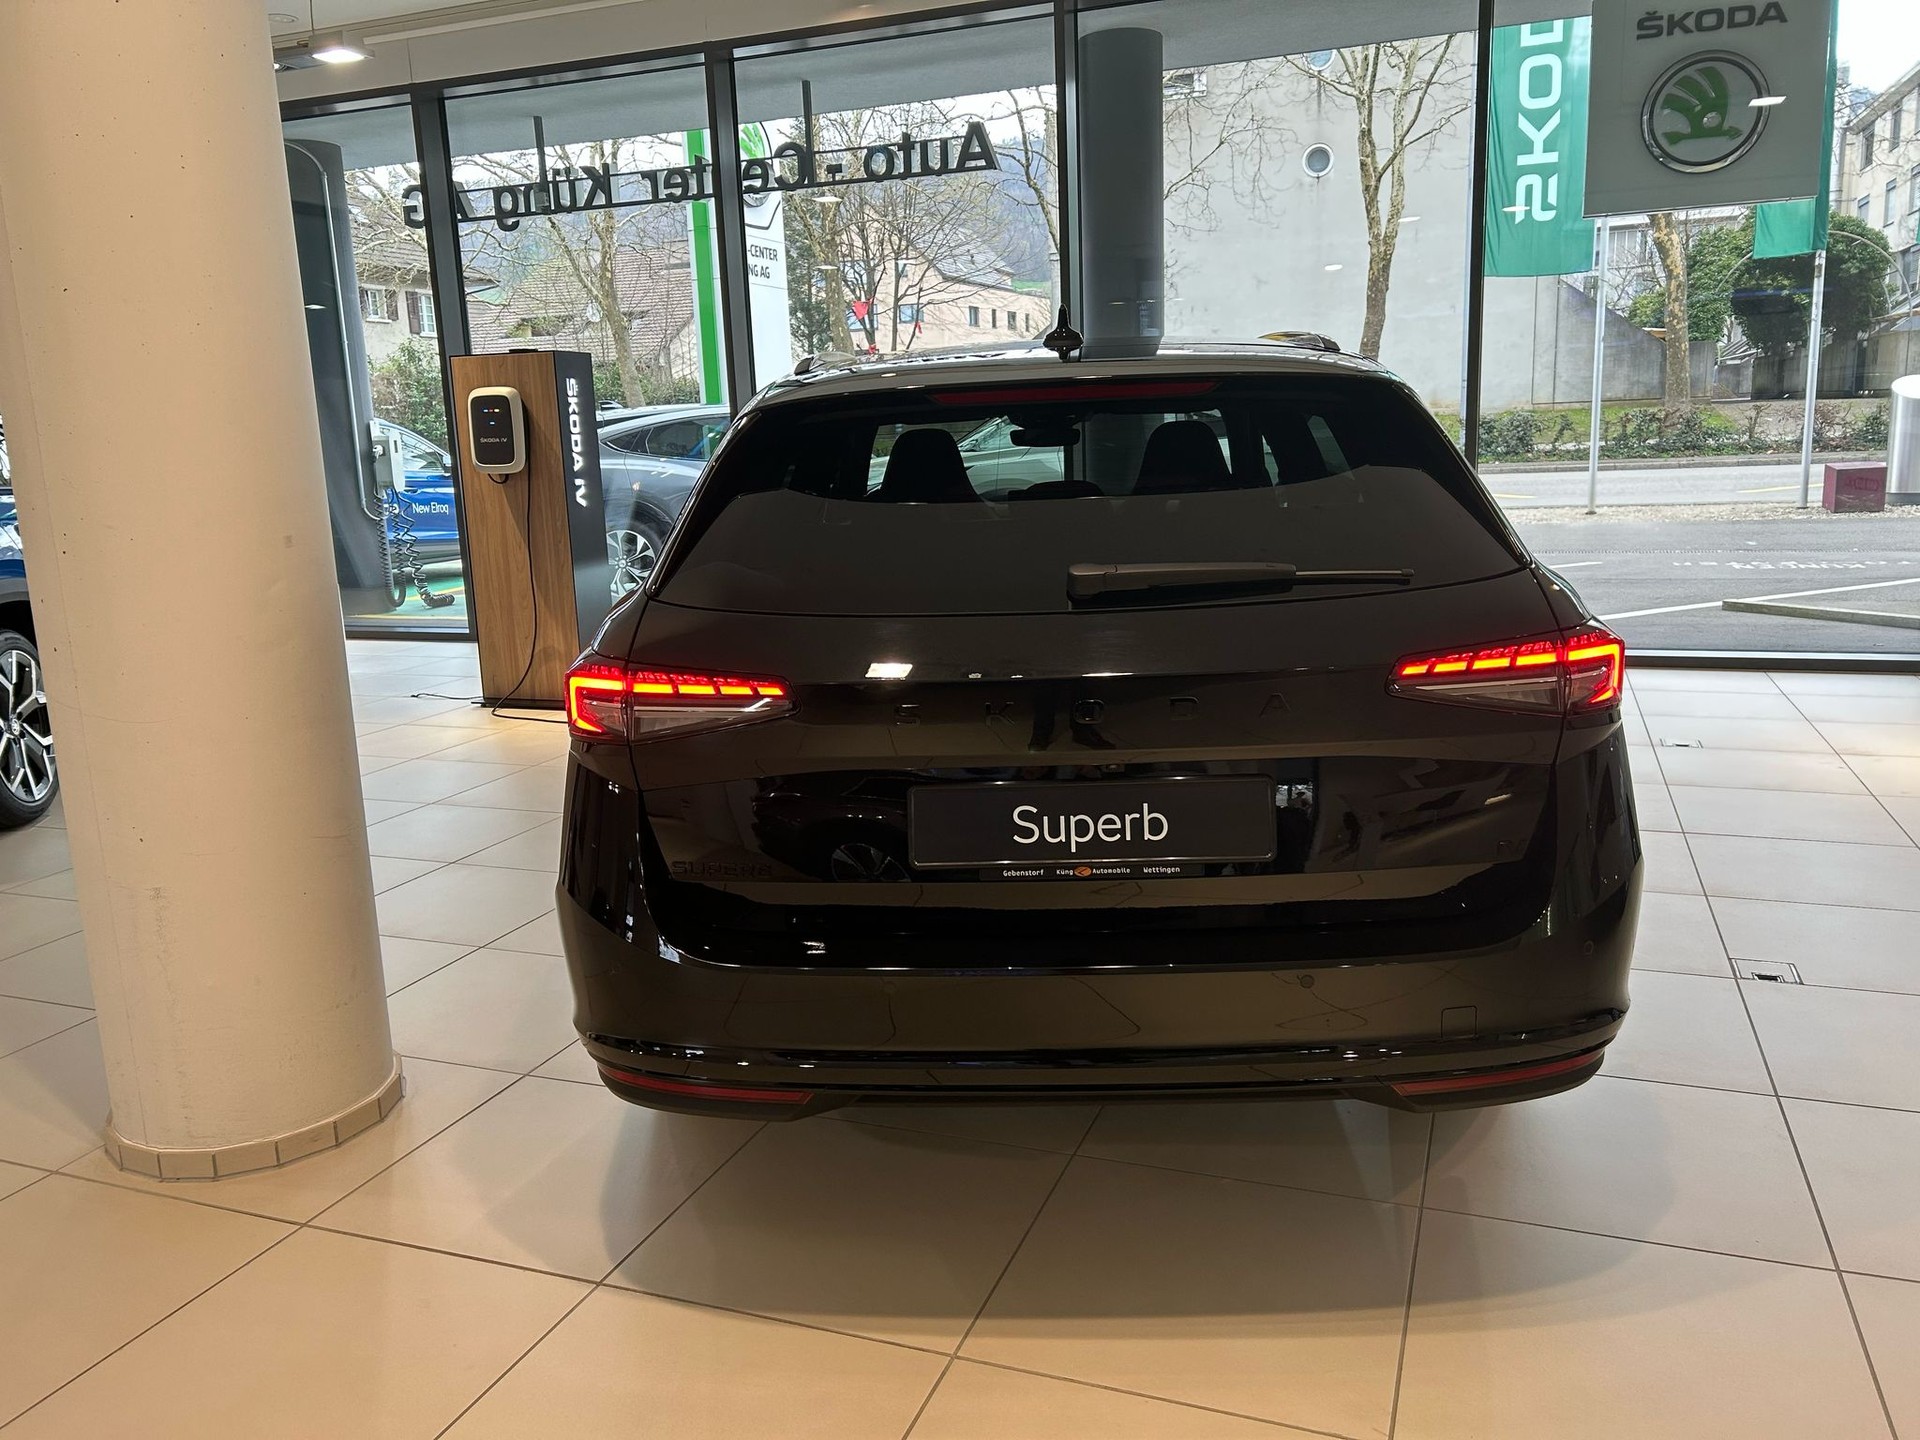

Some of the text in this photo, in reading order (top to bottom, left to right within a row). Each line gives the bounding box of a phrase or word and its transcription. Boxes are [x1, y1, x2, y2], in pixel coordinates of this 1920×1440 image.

[1636, 1, 1788, 40] ŠKODA
[760, 265, 771, 279] AG
[412, 503, 429, 514] New
[431, 502, 449, 515] Elroq
[1012, 803, 1169, 853] Superb
[671, 860, 773, 877] SUPERB
[1003, 866, 1180, 877] Gebenstorf Küng Automobile Wettingen
